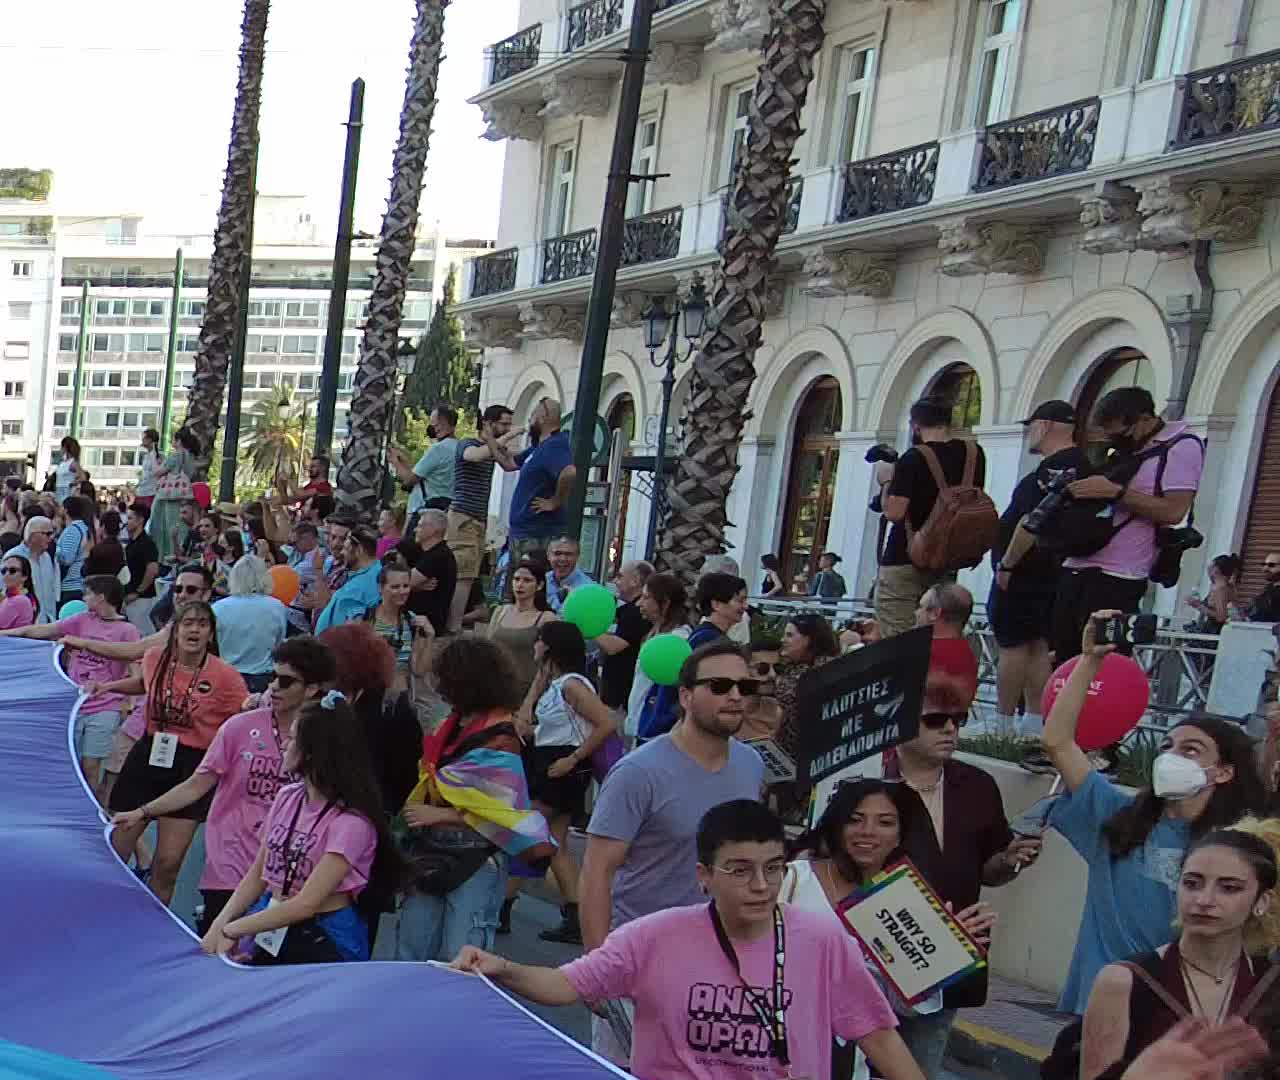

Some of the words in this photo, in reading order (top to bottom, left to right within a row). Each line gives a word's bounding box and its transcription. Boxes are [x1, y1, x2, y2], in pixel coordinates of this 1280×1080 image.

[875, 908, 930, 971] STRAIGHT?
[895, 908, 924, 936] WHY
[917, 936, 936, 955] SO
